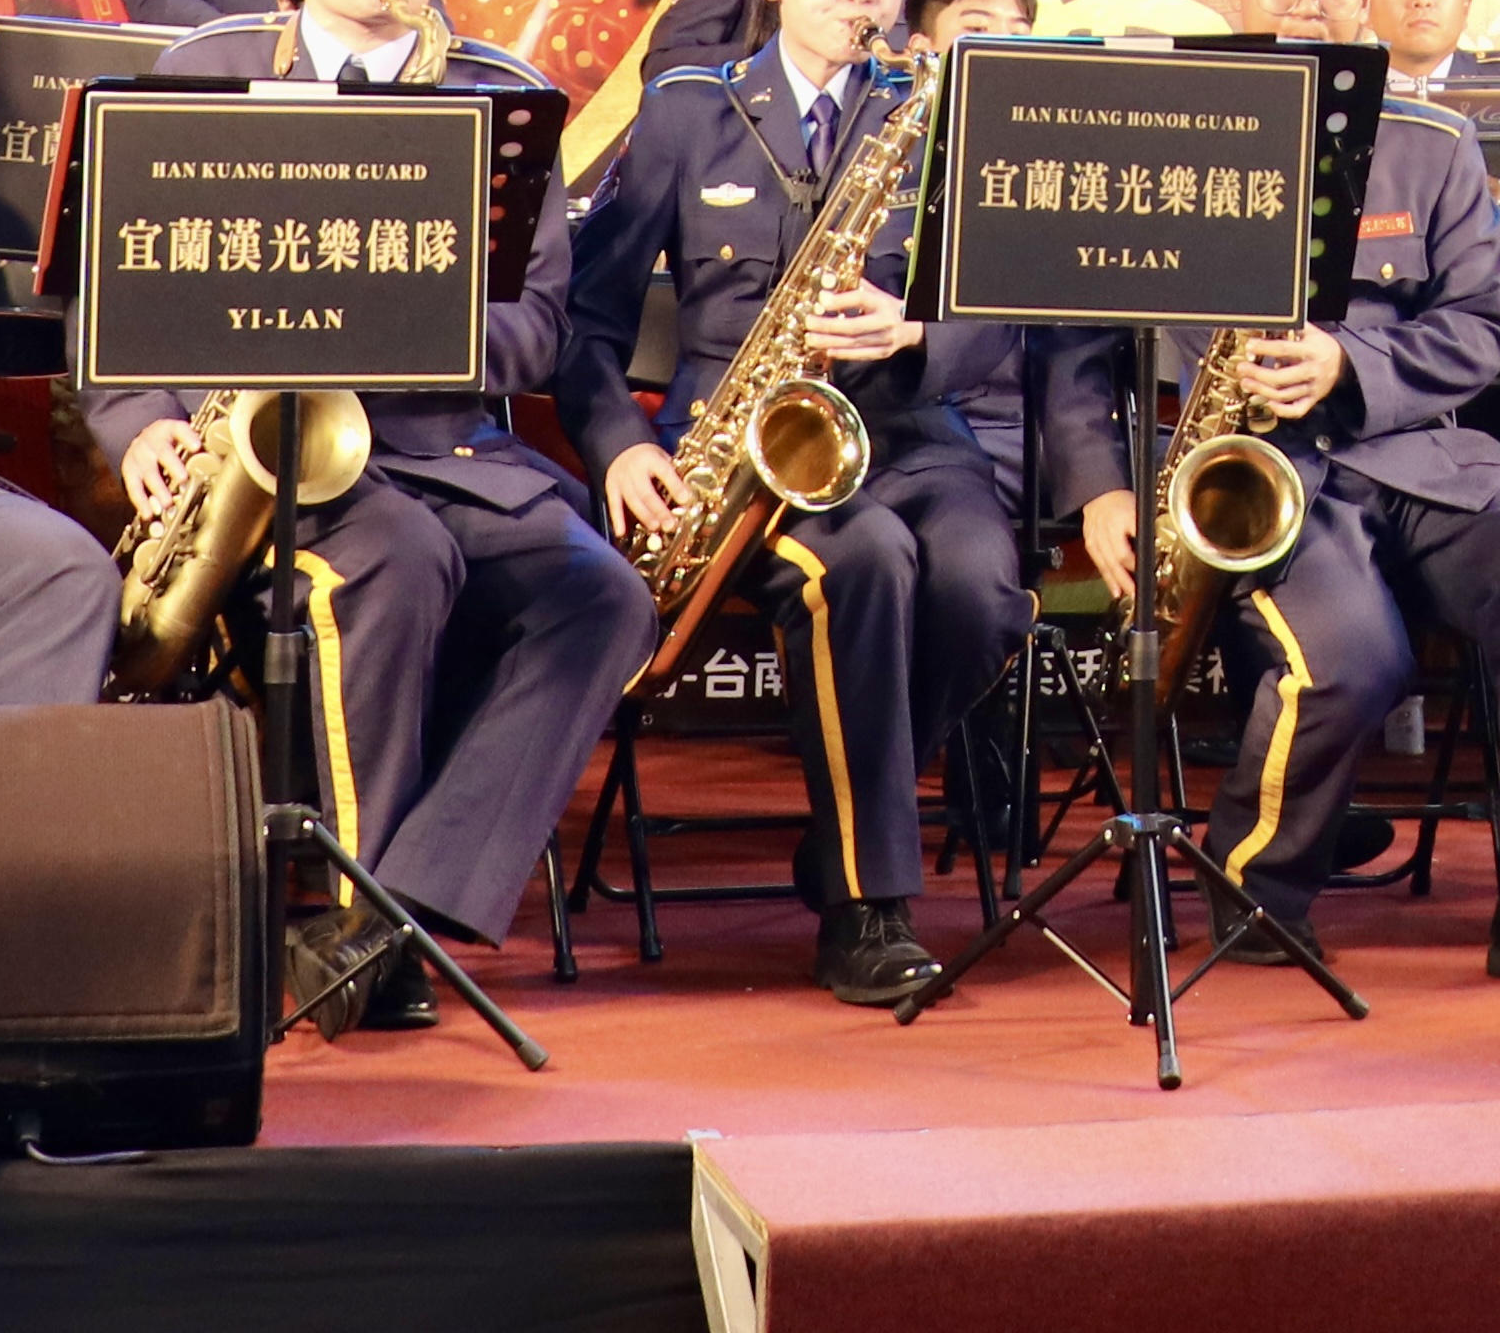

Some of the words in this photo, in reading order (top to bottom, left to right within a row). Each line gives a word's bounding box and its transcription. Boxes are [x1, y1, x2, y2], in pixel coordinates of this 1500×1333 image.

[1011, 105, 1052, 123] HAN
[1056, 107, 1122, 126] KUANG
[1127, 111, 1191, 129] HONOR
[1194, 113, 1260, 132] GUARD
[151, 161, 197, 179] HAN
[201, 162, 275, 180] KUANG
[280, 162, 351, 180] HONOR
[355, 163, 428, 181] GUARD
[978, 158, 1287, 223] 宜蘭漢光樂儀隊
[117, 217, 458, 275] 宜蘭漢光樂儀隊
[1076, 245, 1182, 270] YI-LAN
[227, 308, 344, 330] YI-LAN
